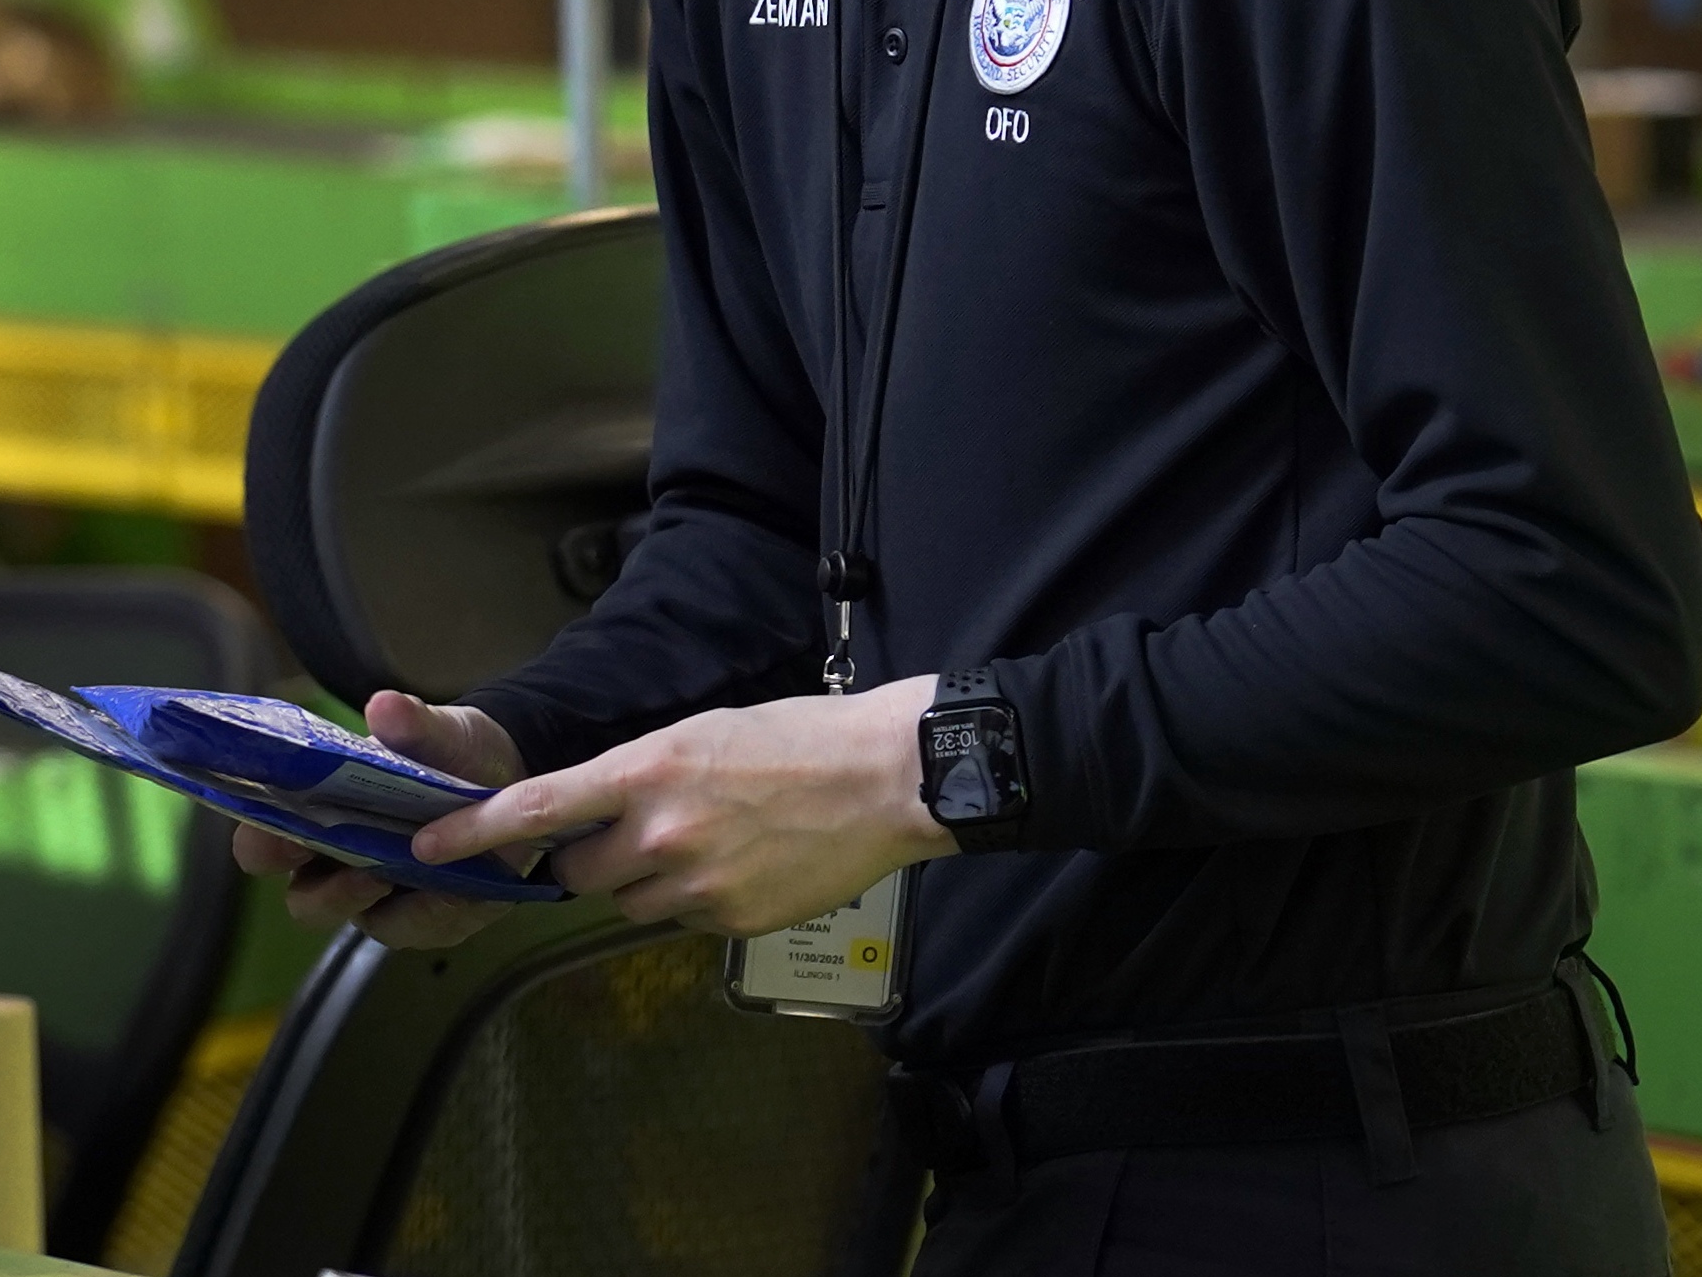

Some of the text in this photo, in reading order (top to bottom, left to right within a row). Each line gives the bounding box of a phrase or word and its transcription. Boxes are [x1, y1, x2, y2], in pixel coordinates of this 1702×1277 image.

[1006, 29, 1056, 82] SECURITY
[985, 106, 1030, 143] OFO
[932, 730, 981, 751] 10:32
[788, 951, 845, 965] 11/30/2025
[793, 969, 833, 981] ILLINOIS
